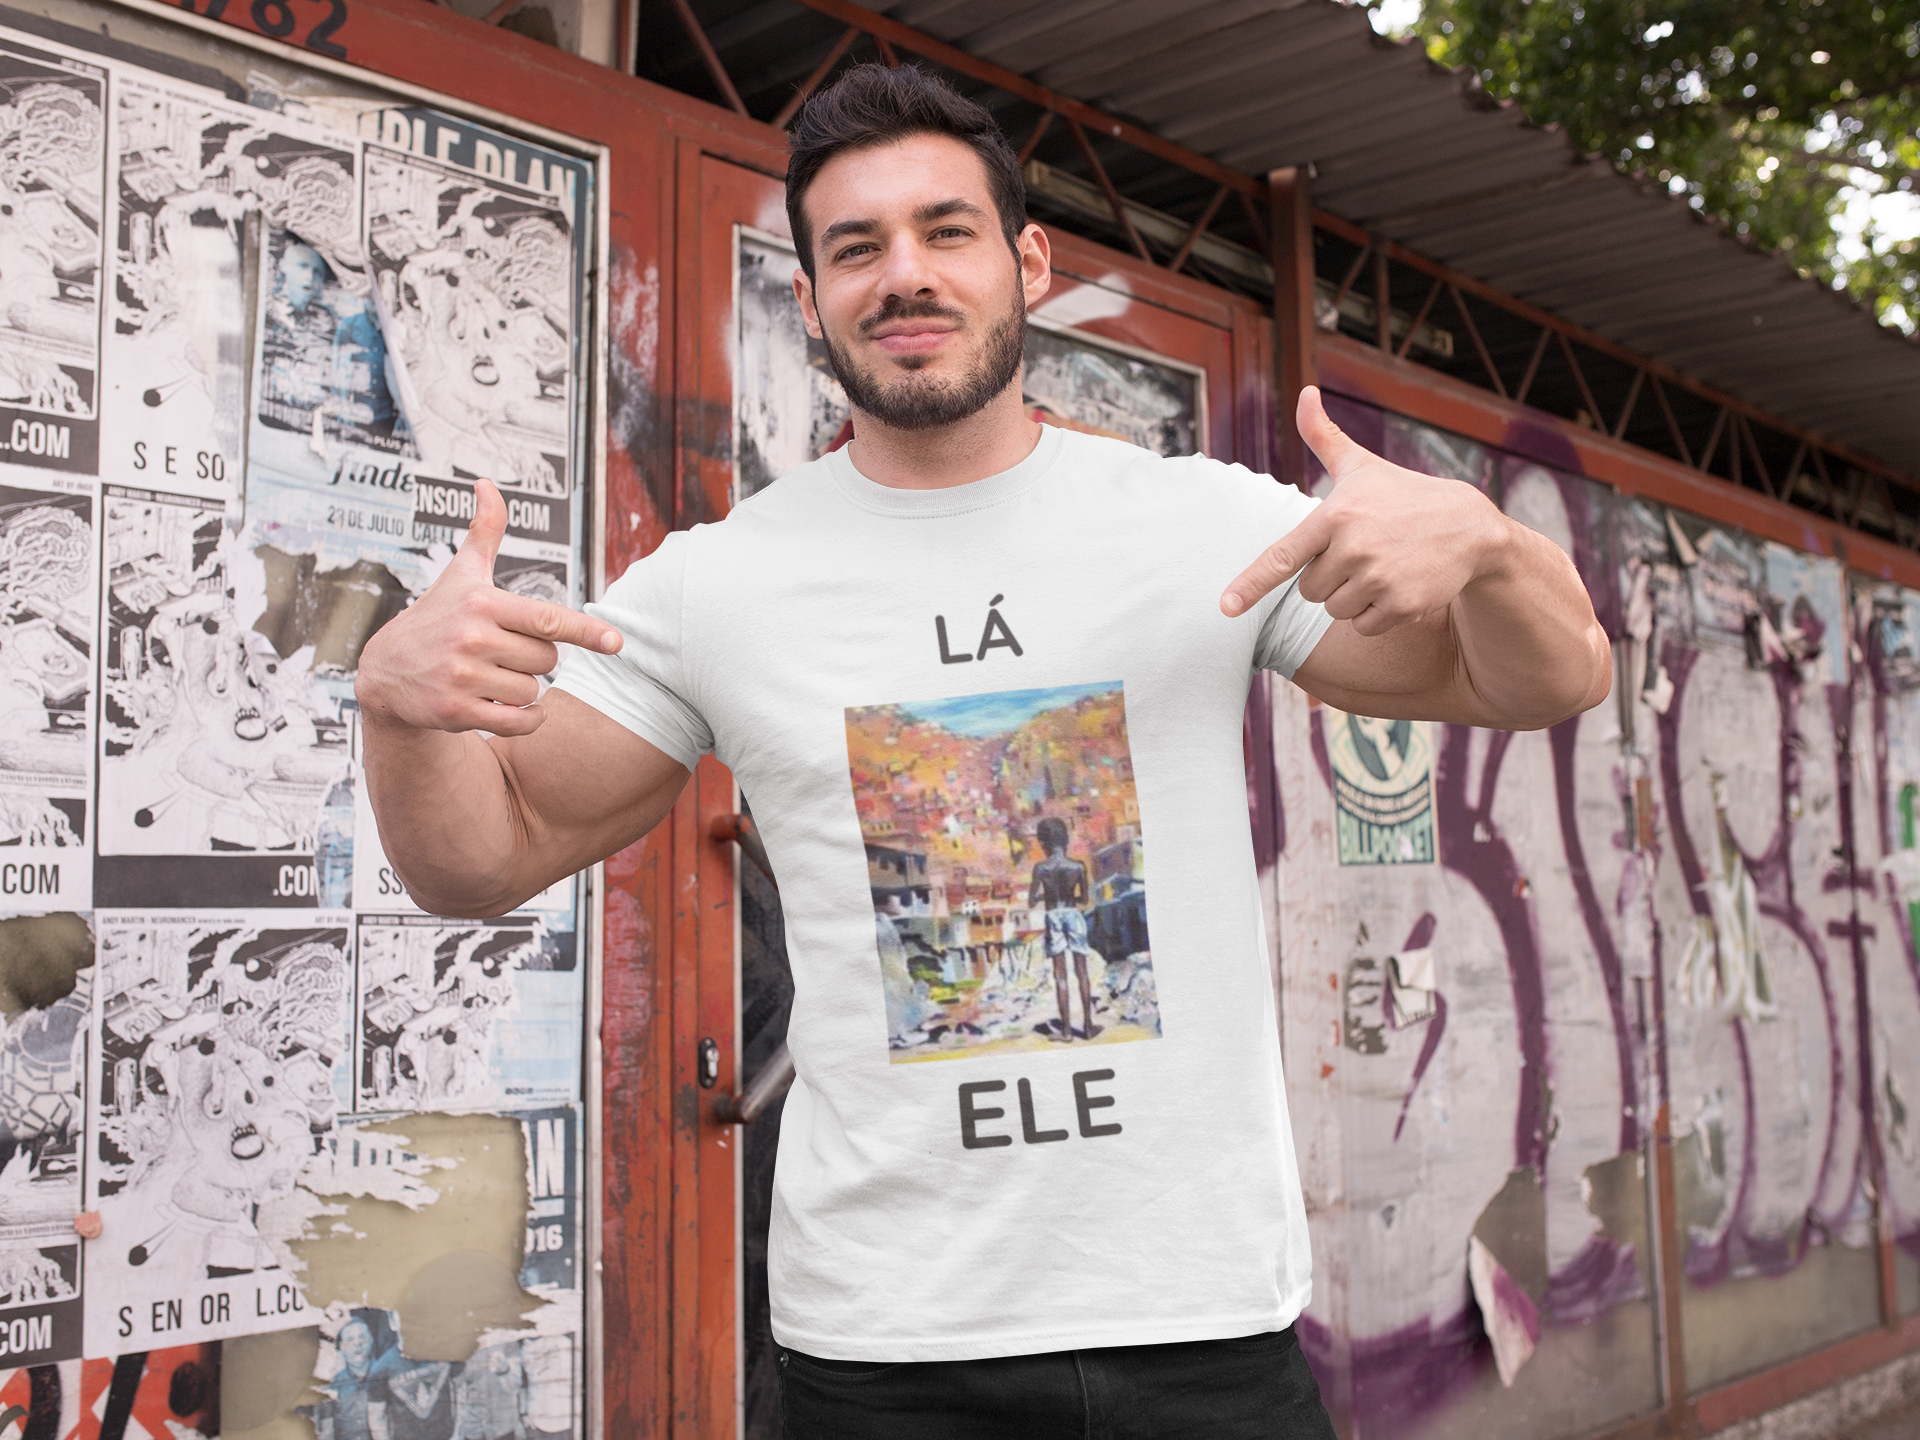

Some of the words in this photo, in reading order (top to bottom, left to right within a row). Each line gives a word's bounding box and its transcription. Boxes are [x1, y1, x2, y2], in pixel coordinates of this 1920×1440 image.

[0, 418, 70, 459] .COM
[133, 441, 147, 469] S
[165, 446, 177, 474] E
[367, 513, 404, 537] JULIO
[935, 593, 1023, 665] LÁ
[958, 1068, 1123, 1150] ELE
[118, 1306, 133, 1337] S
[152, 1299, 182, 1333] EN
[200, 1293, 230, 1325] OR
